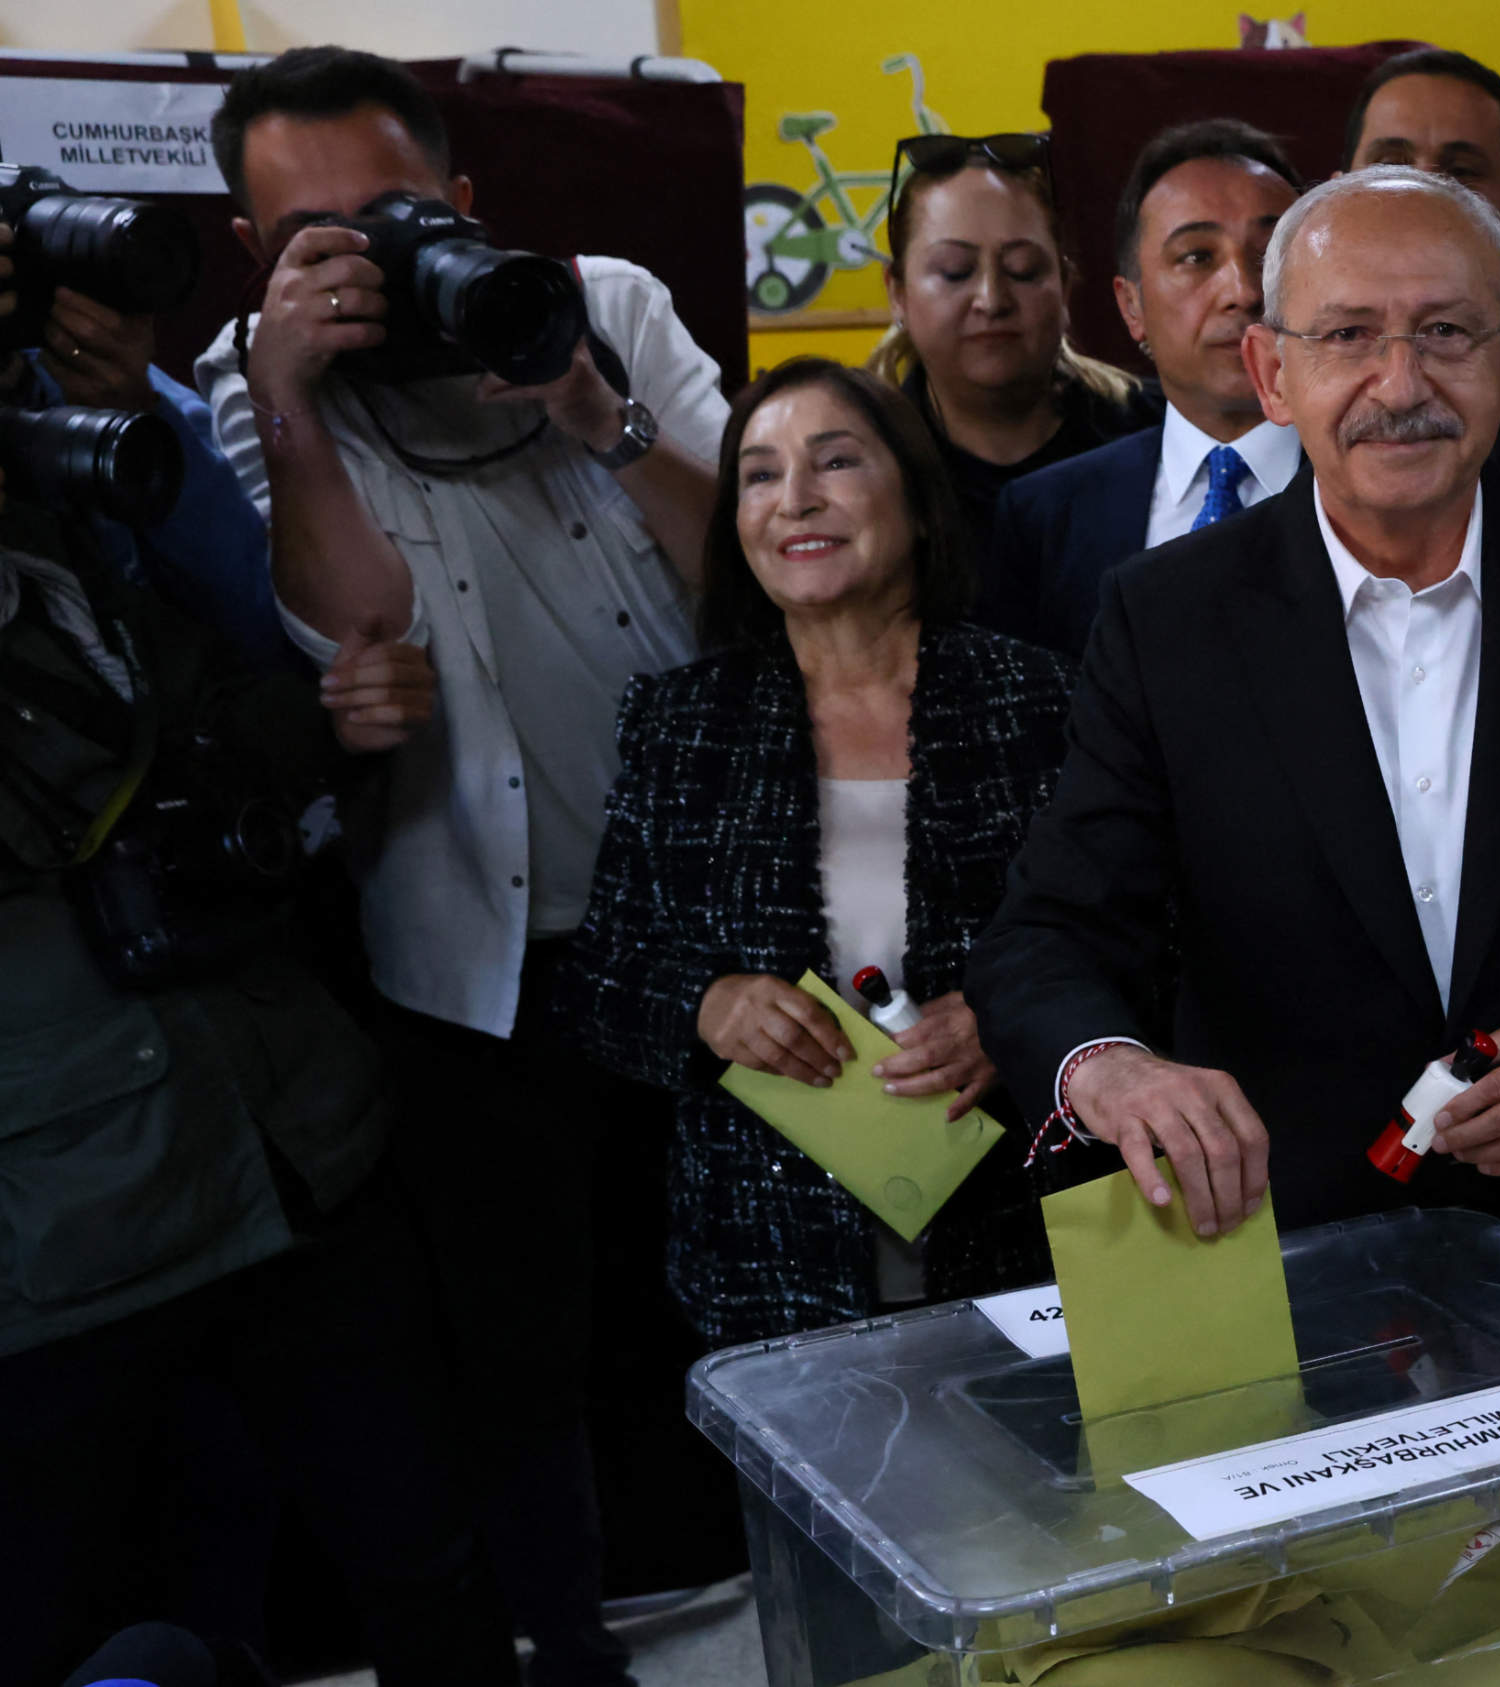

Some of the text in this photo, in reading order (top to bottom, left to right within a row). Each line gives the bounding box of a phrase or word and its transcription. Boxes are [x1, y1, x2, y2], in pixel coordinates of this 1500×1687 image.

[53, 121, 210, 145] CUMHURBAŞK
[60, 143, 207, 166] MİLLETVEKİLİ
[1234, 1482, 1281, 1500] VE
